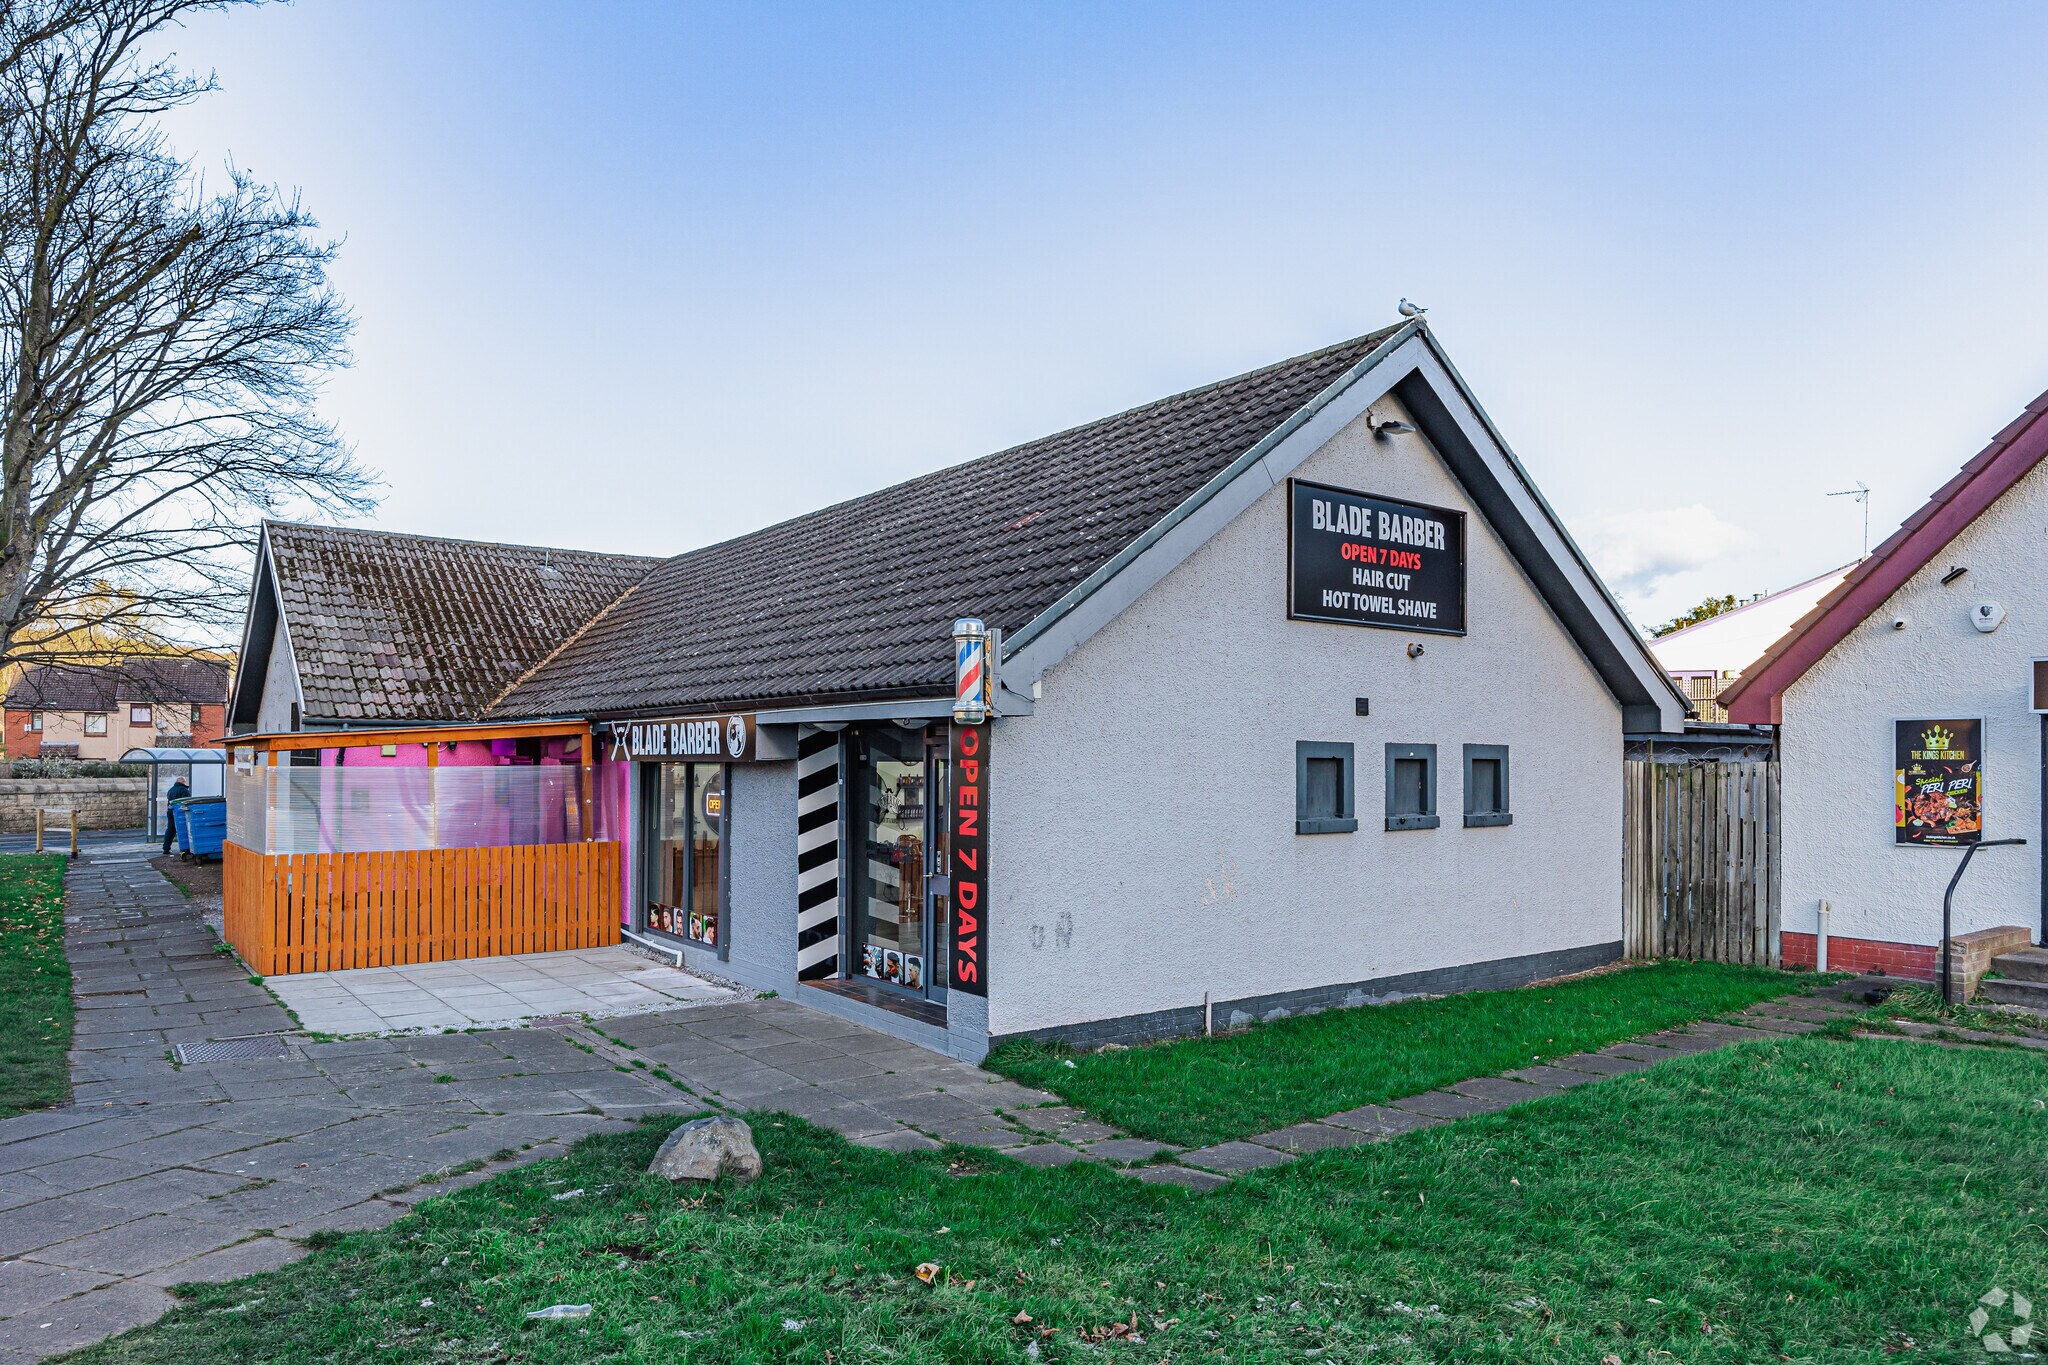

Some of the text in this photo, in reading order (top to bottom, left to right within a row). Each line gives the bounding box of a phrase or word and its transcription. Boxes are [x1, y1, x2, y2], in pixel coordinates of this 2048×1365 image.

[1312, 499, 1445, 550] BLADE BARBER
[1341, 542, 1421, 570] OPEN 7 DAYS
[1352, 567, 1411, 591] HAIR CUT
[1322, 590, 1437, 619] HOT TOWEL SHAVE
[632, 720, 721, 756] BLADE BARBER
[1911, 750, 1965, 760] THE KINGS KITCHEN
[1915, 773, 1944, 787] Special
[1920, 778, 1973, 795] PERI PERI
[709, 799, 720, 810] OPE
[958, 728, 979, 983] OPEN 7 DAYS
